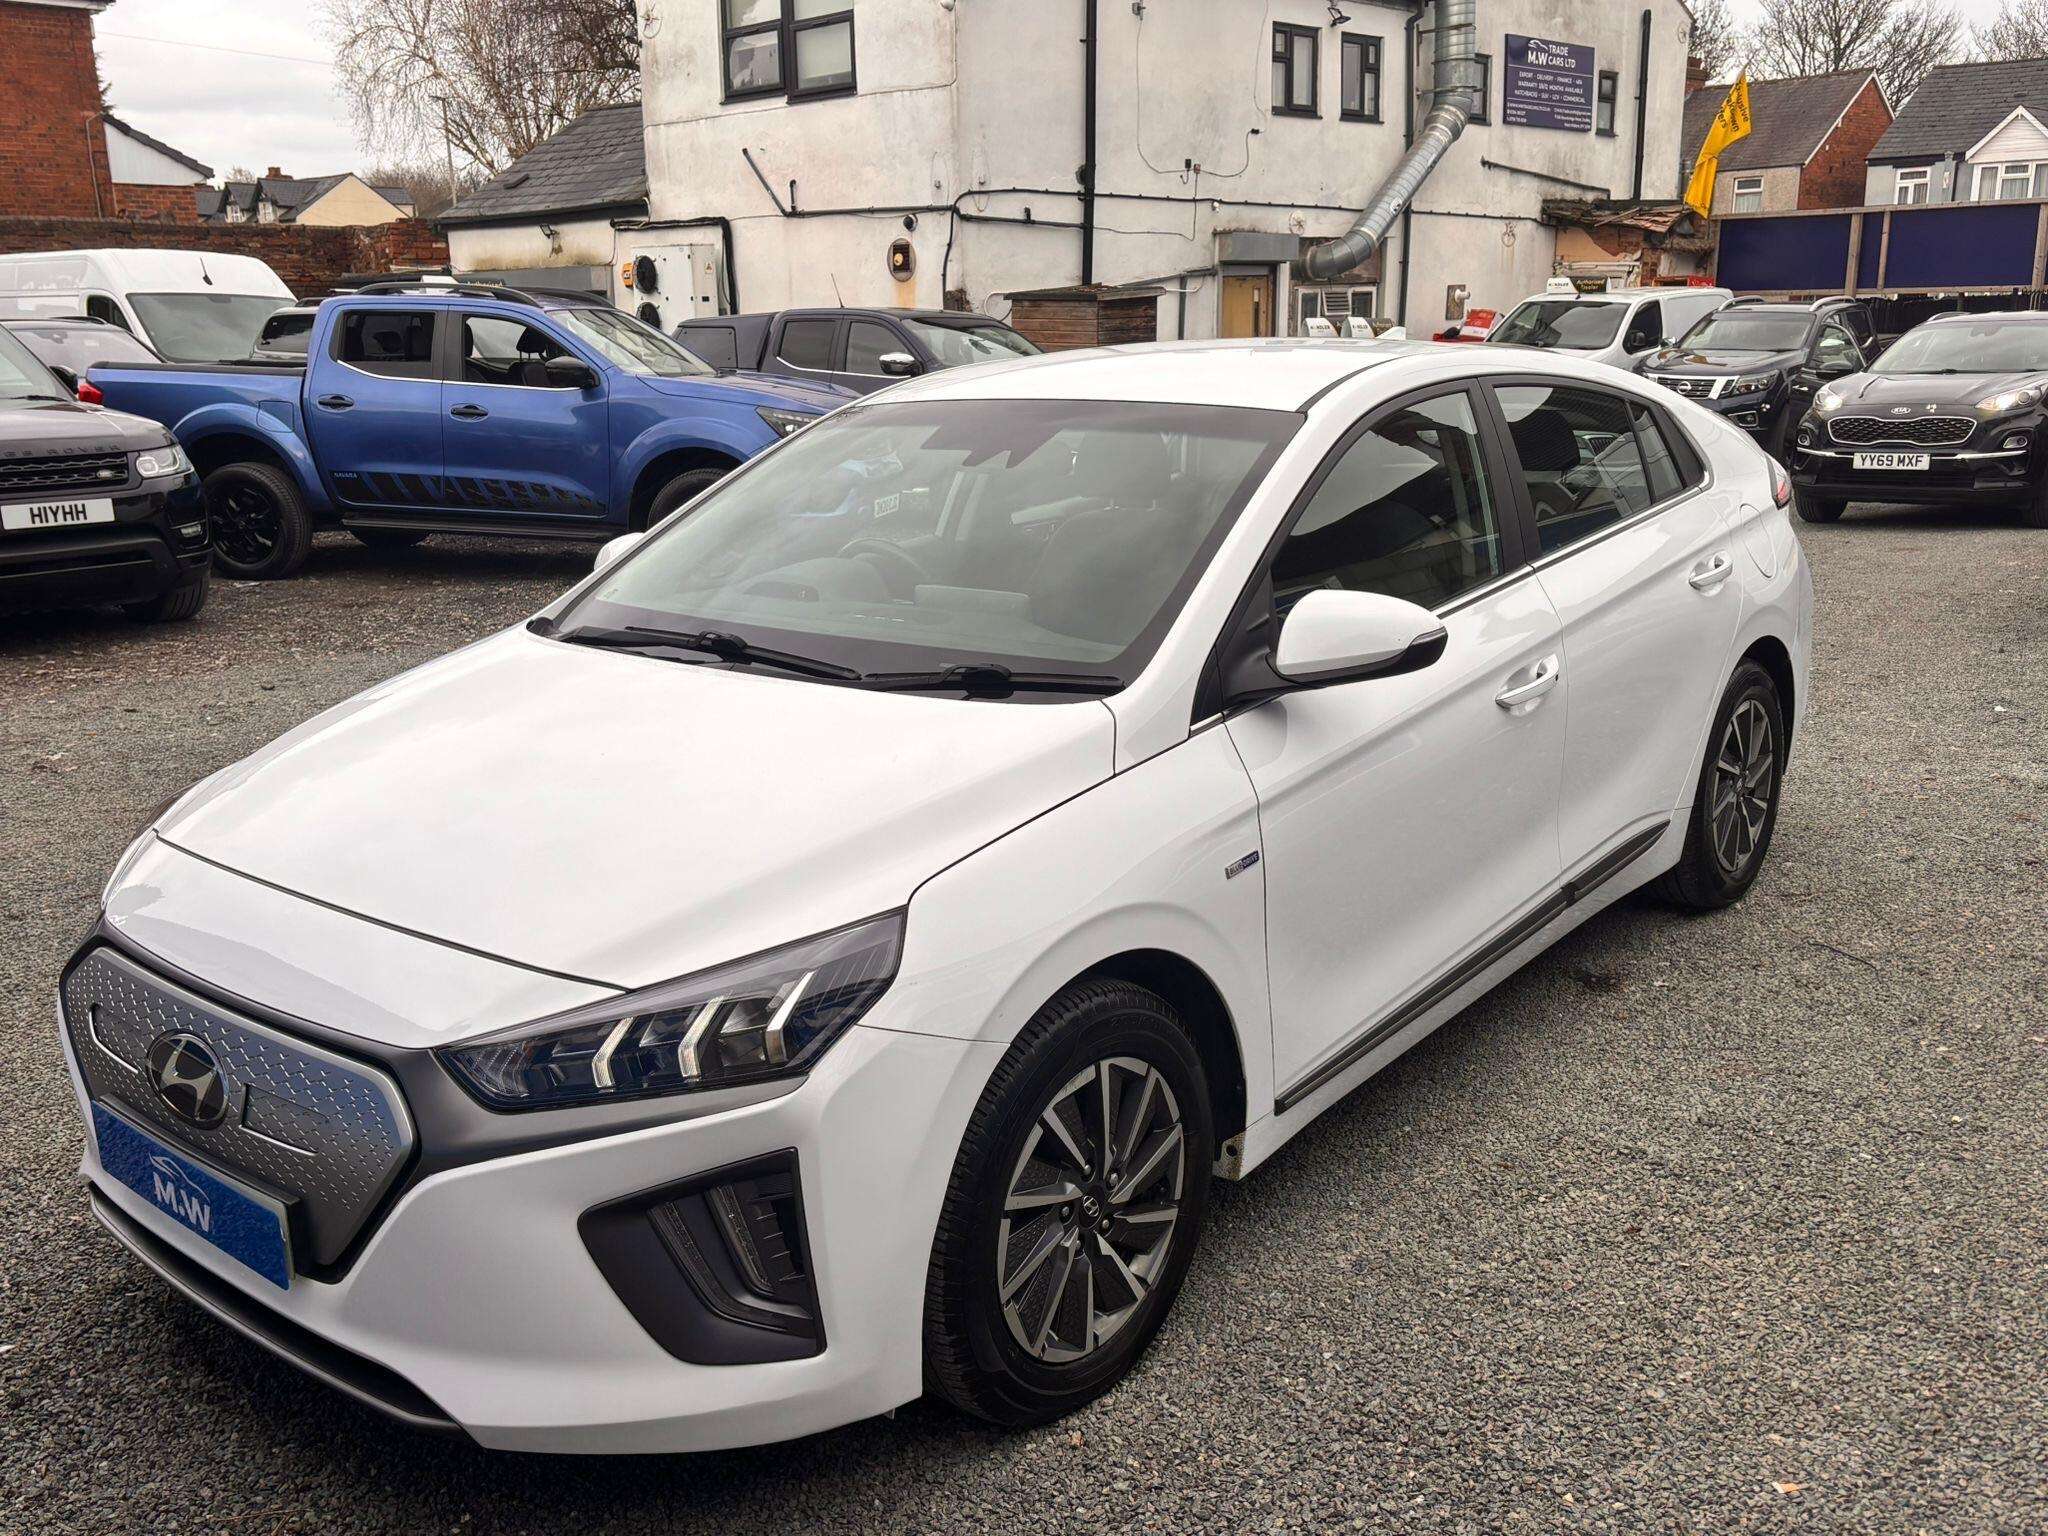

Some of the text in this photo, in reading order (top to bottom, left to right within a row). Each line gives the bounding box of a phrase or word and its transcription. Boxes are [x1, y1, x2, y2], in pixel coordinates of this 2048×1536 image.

[1549, 44, 1569, 56] TRADE
[1527, 50, 1576, 69] M.W CARS LTD
[1860, 454, 1924, 467] YY69 MXF
[153, 1171, 210, 1232] M.W
